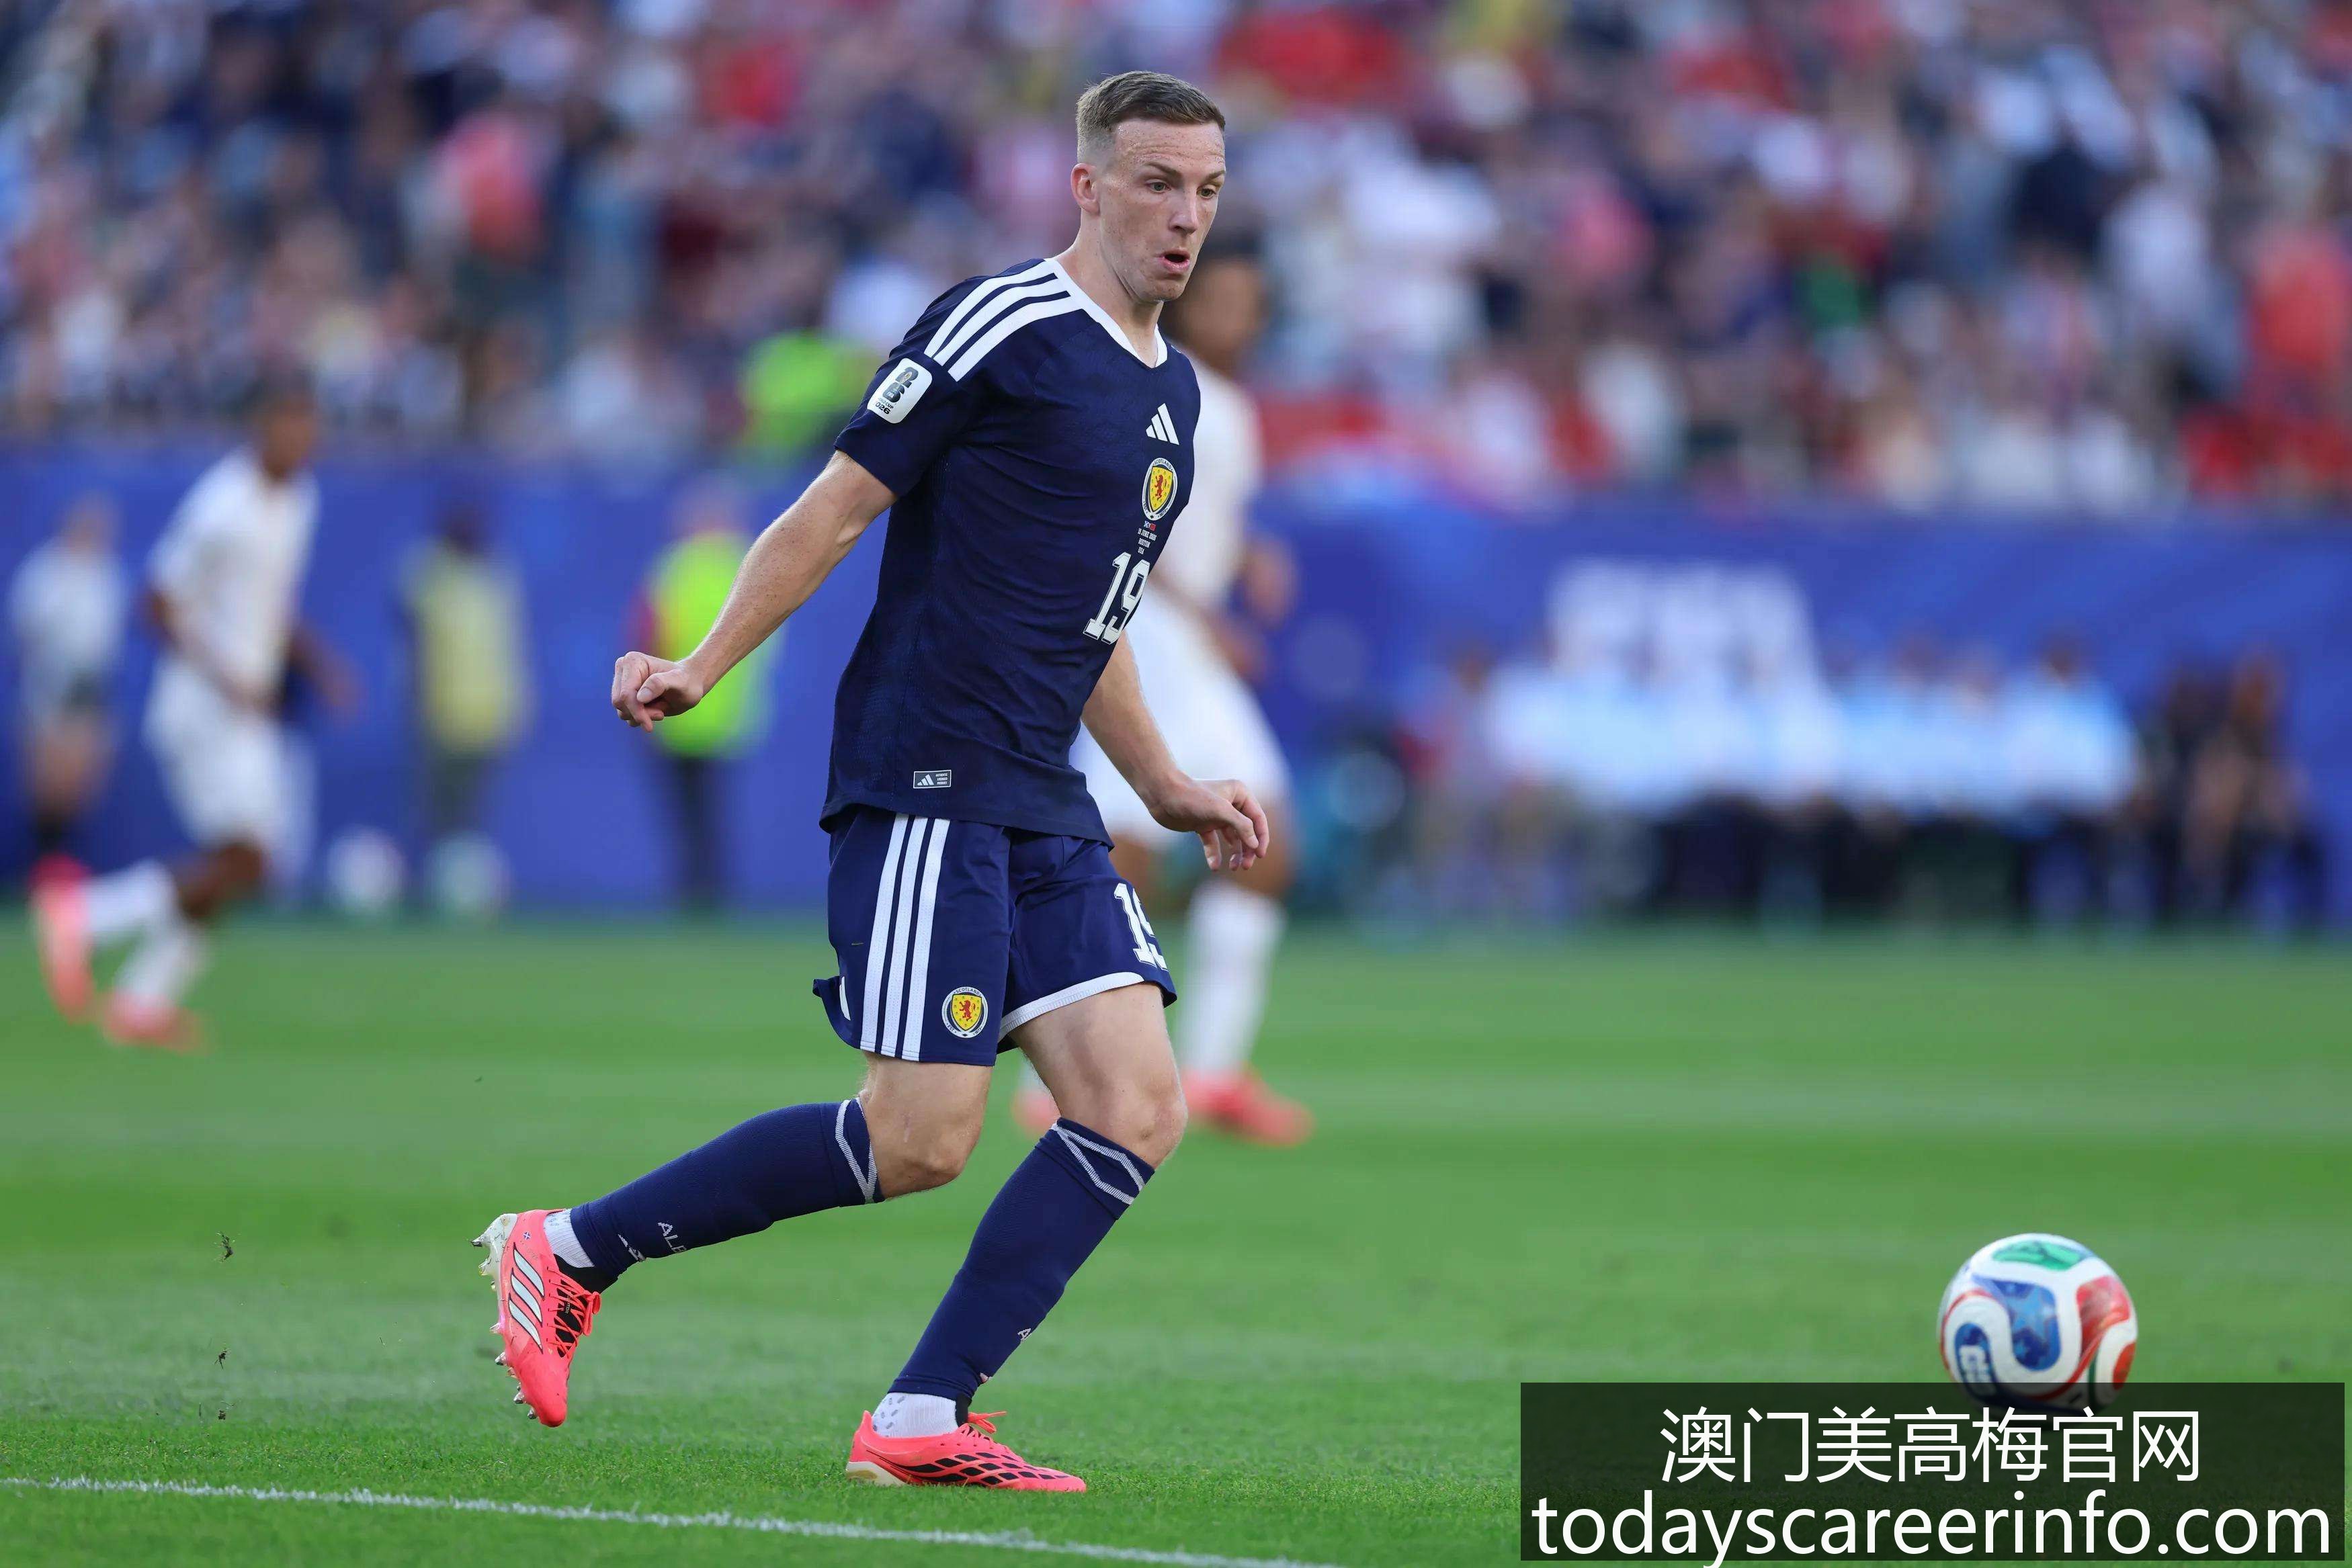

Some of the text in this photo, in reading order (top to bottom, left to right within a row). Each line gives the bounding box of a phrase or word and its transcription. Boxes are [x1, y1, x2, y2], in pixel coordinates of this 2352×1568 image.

[875, 402, 891, 415] 026
[1154, 459, 1172, 470] SCOTLAND
[1083, 552, 1150, 645] 19
